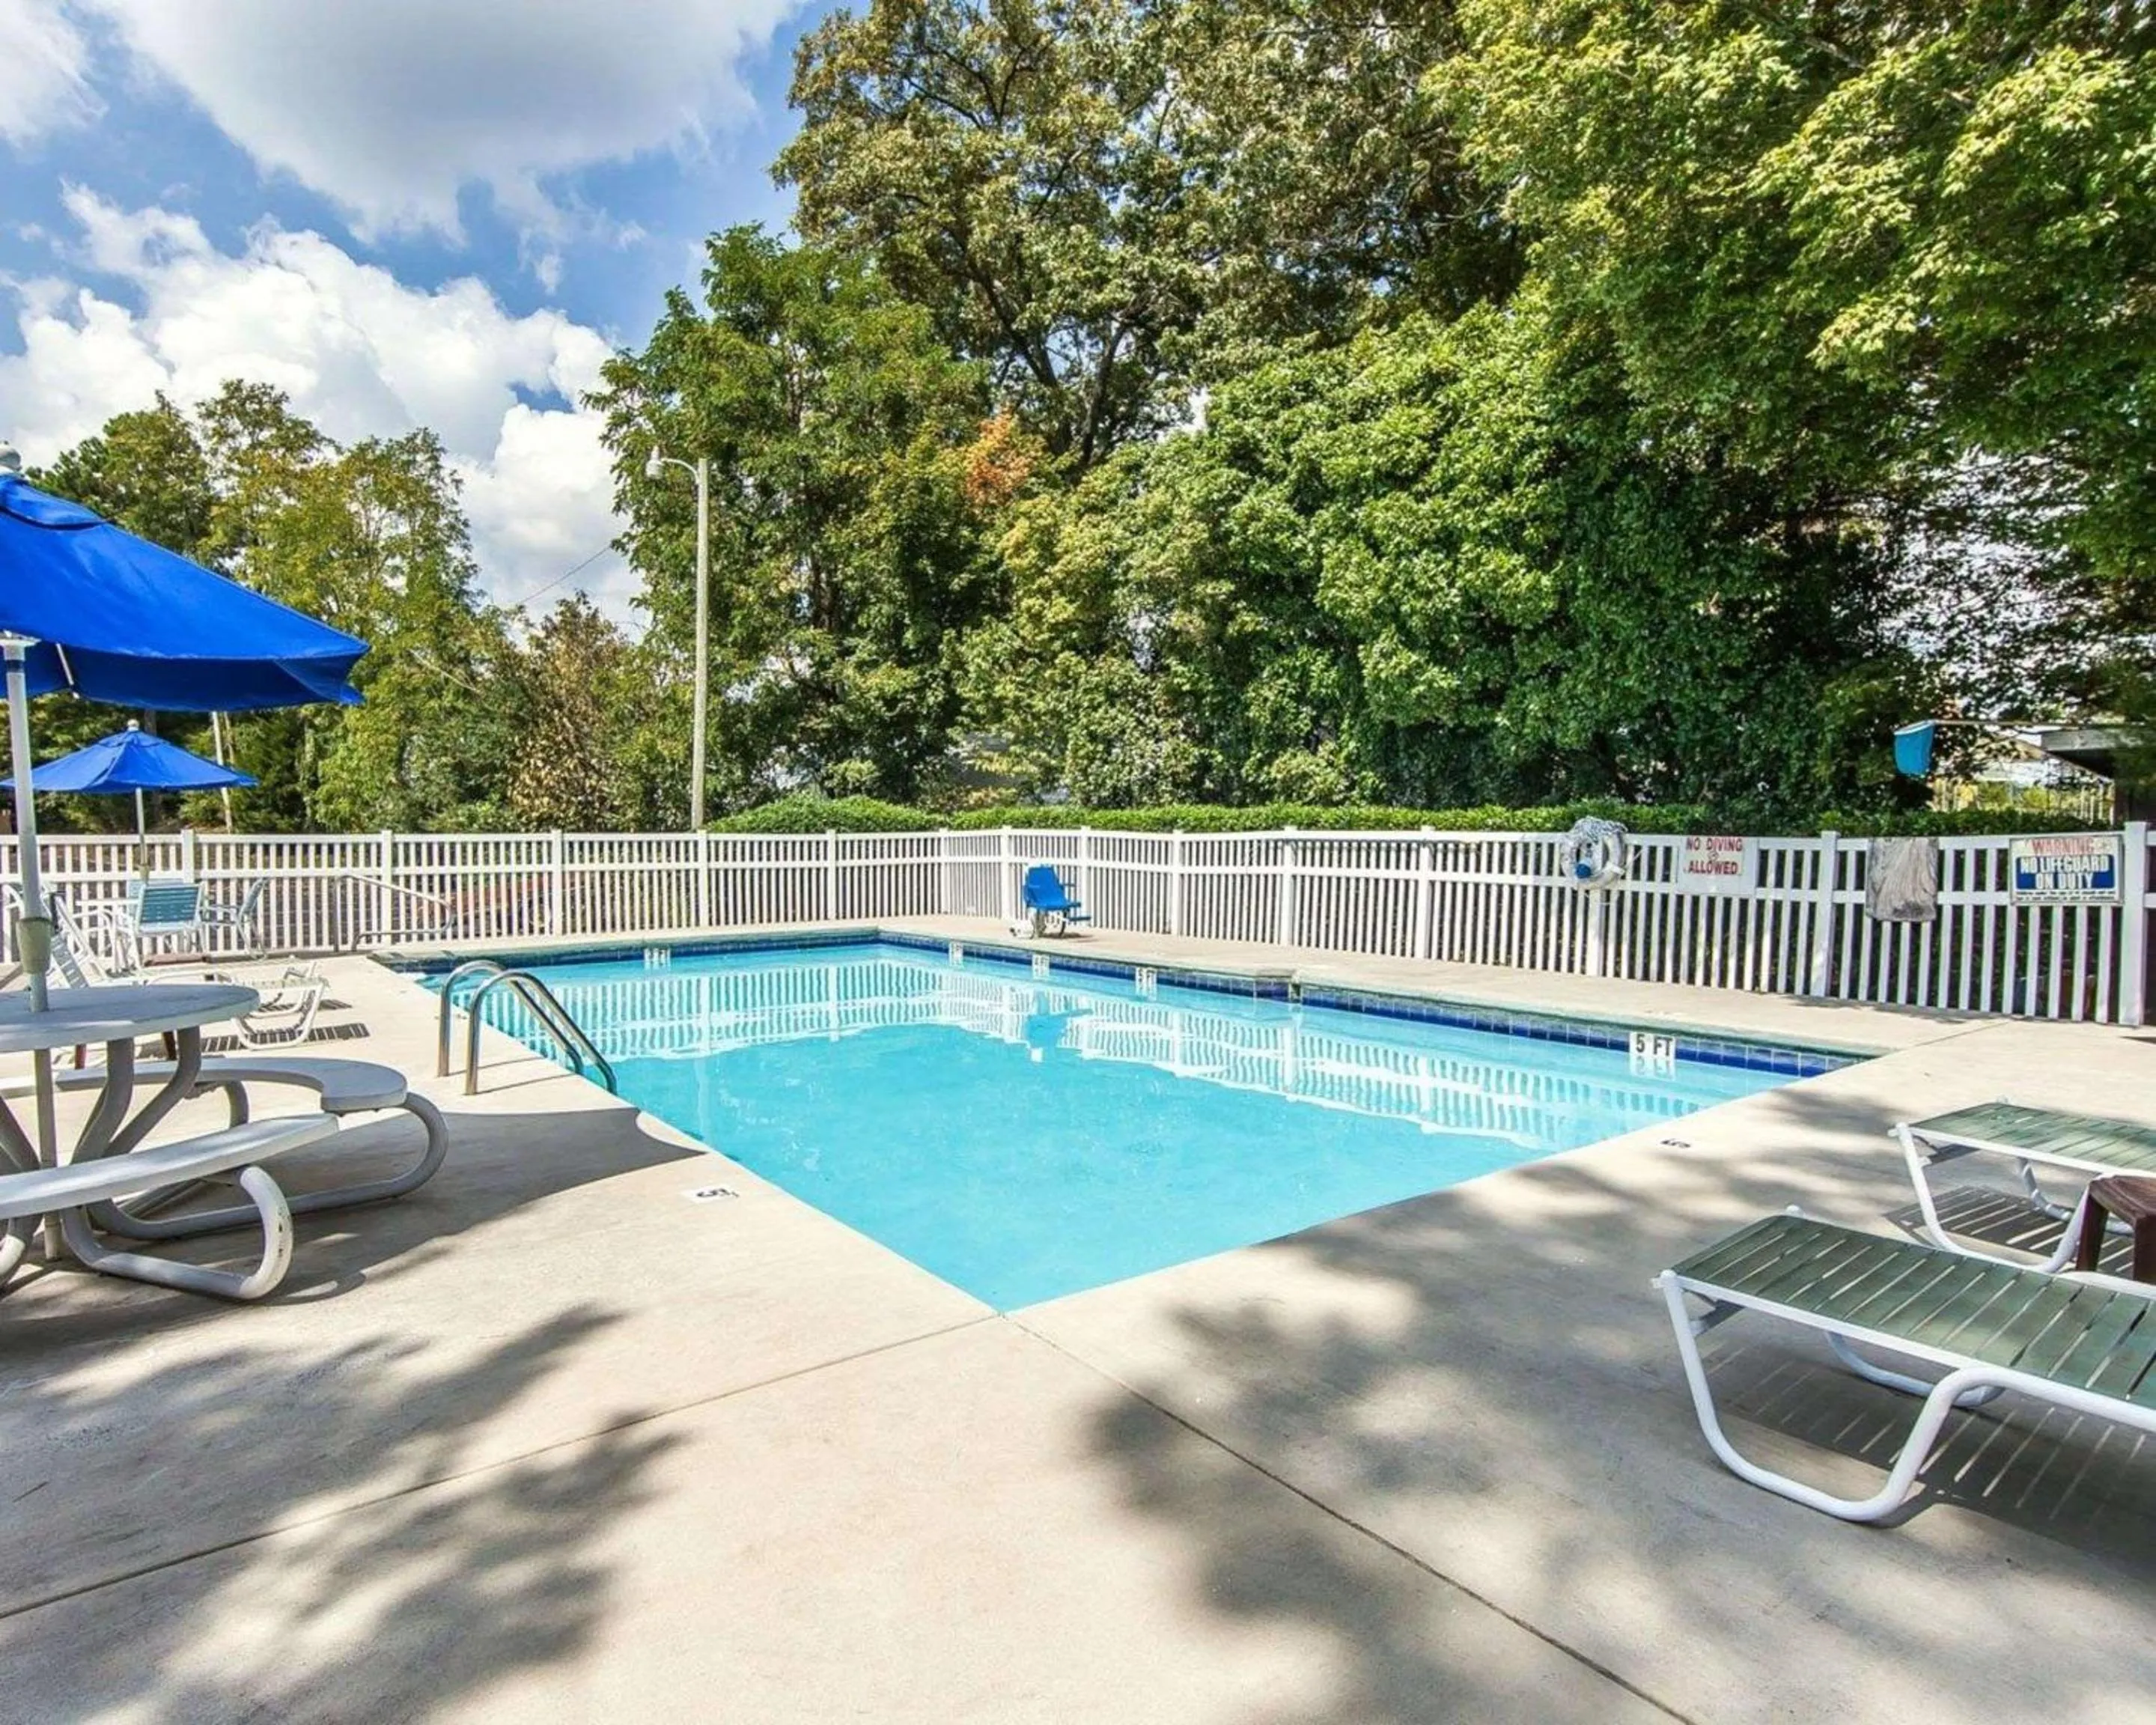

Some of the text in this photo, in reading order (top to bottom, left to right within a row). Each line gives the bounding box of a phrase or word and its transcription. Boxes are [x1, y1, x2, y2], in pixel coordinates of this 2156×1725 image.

[1686, 837, 1744, 852] NO DIVING
[2032, 836, 2095, 855] WARNING
[1688, 861, 1738, 875] ALLOWED
[2020, 854, 2110, 874] NO LIFEGUARD
[2035, 871, 2094, 890] ON DUTY
[1636, 1033, 1673, 1056] 5 FT
